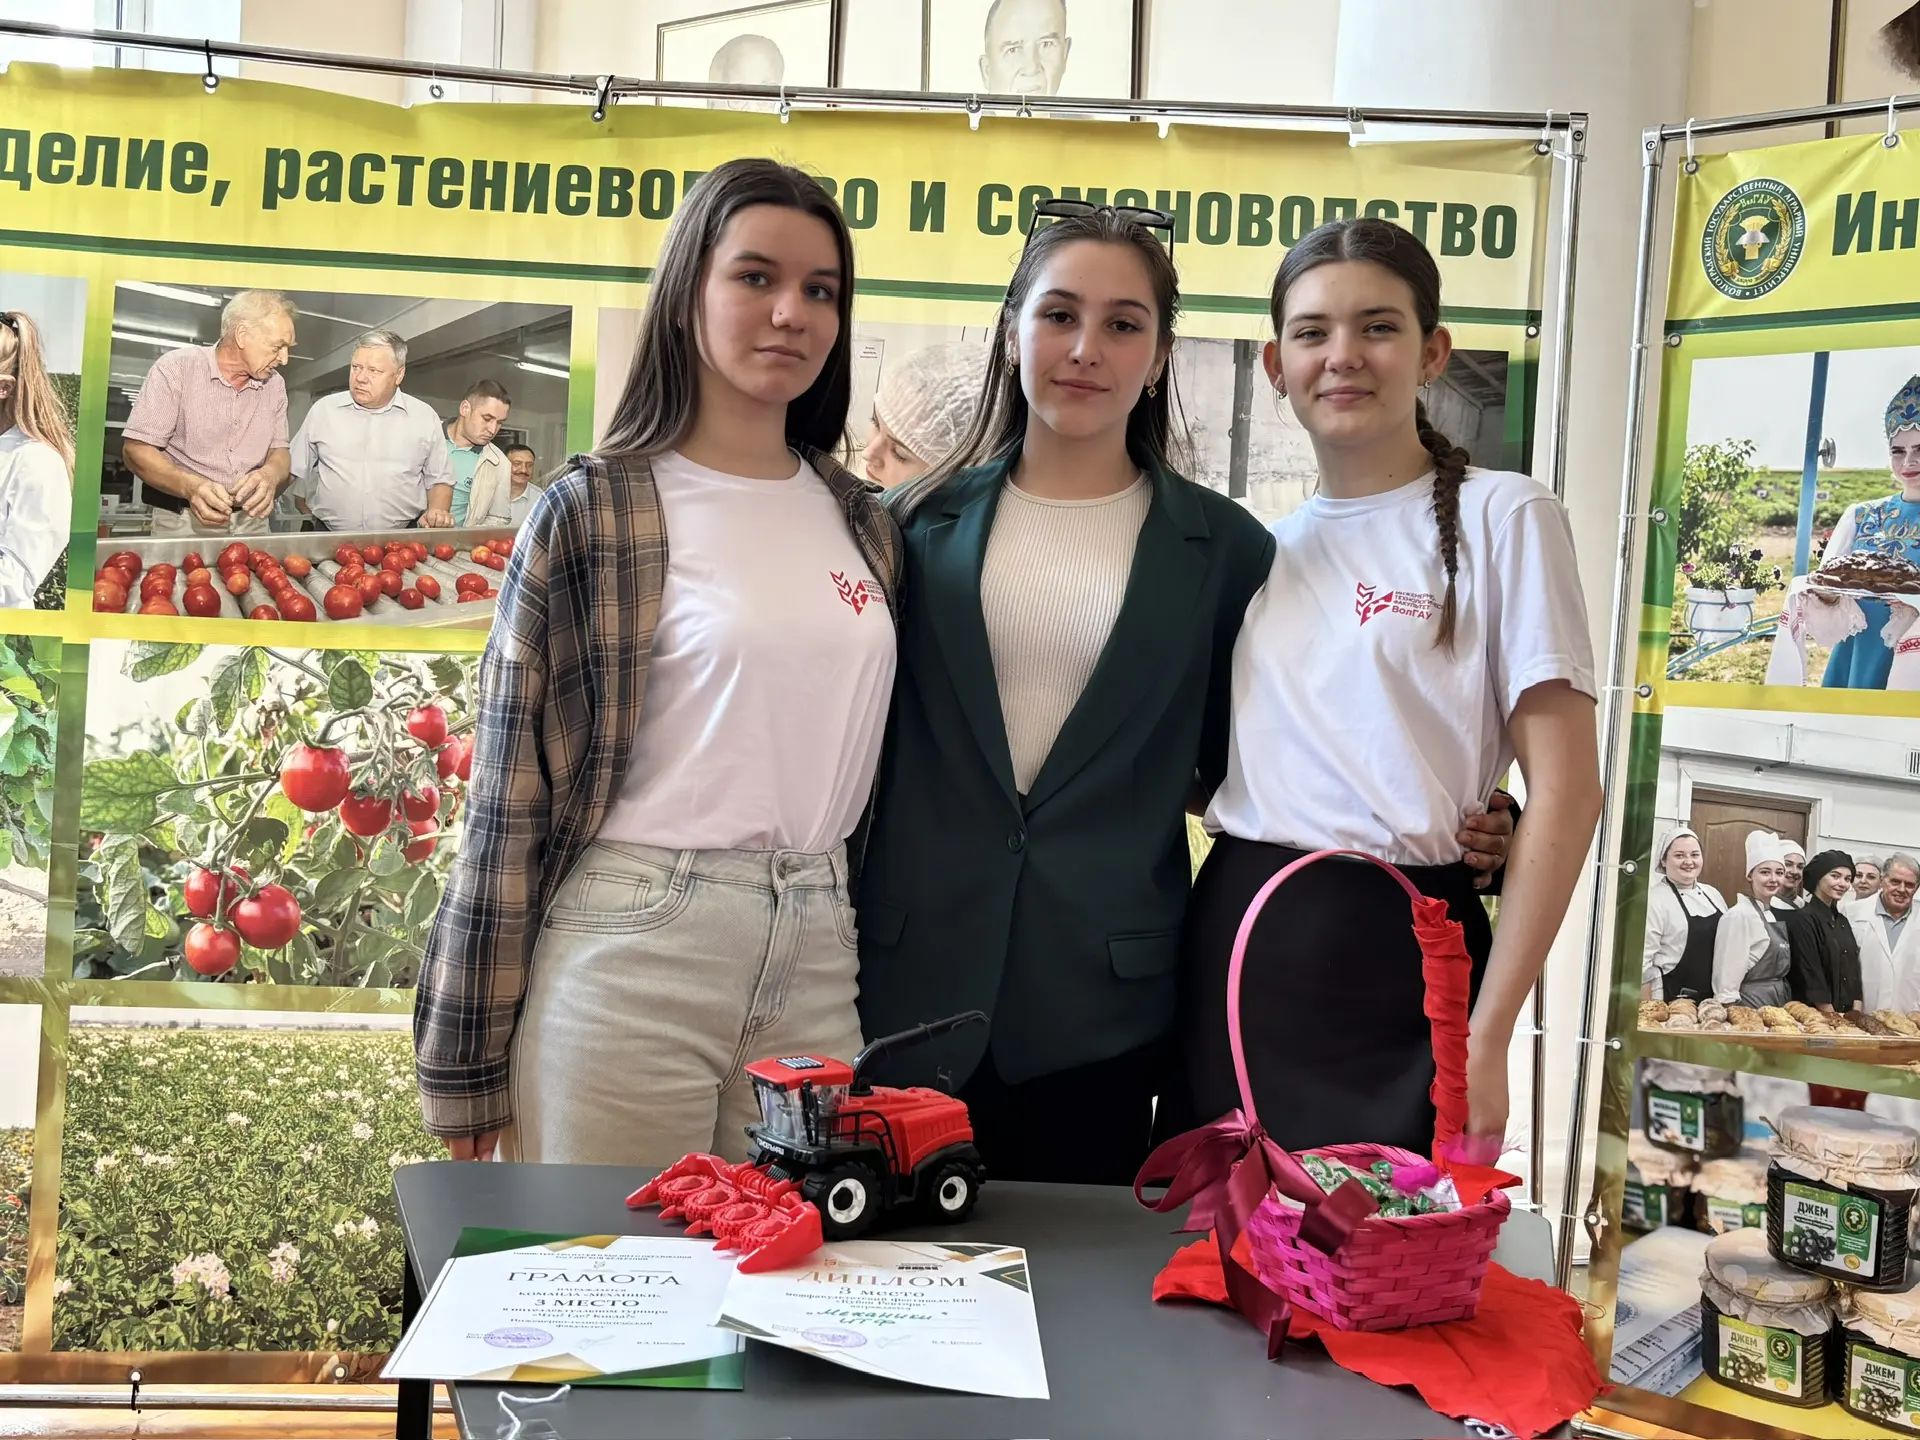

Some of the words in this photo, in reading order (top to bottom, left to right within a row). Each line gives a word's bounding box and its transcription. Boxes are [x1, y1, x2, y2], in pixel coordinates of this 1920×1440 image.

[0, 128, 231, 207] делие,
[262, 147, 878, 231] растениевоо
[909, 180, 946, 233] и
[1707, 181, 1785, 232] ГОСУДАРСТВЕННЫЙ
[1784, 193, 1804, 238] АГРАРНЫЙ
[1832, 190, 1920, 256] Ин
[1704, 236, 1742, 297] ВОЛГОГРАДСКИЙ
[1753, 242, 1801, 296] УНИВЕРСИТЕТ
[1392, 605, 1433, 620] ВолГАУ
[1797, 1201, 1829, 1218] ДЖЕМ
[507, 1272, 682, 1286] ГРАМОТА
[797, 1270, 968, 1288] ДИПЛОМ
[534, 1299, 547, 1307] 3
[553, 1299, 641, 1308] МЕСТО
[1730, 1332, 1758, 1348] ДЖЕМ
[1864, 1363, 1896, 1380] ДЖЕМ
